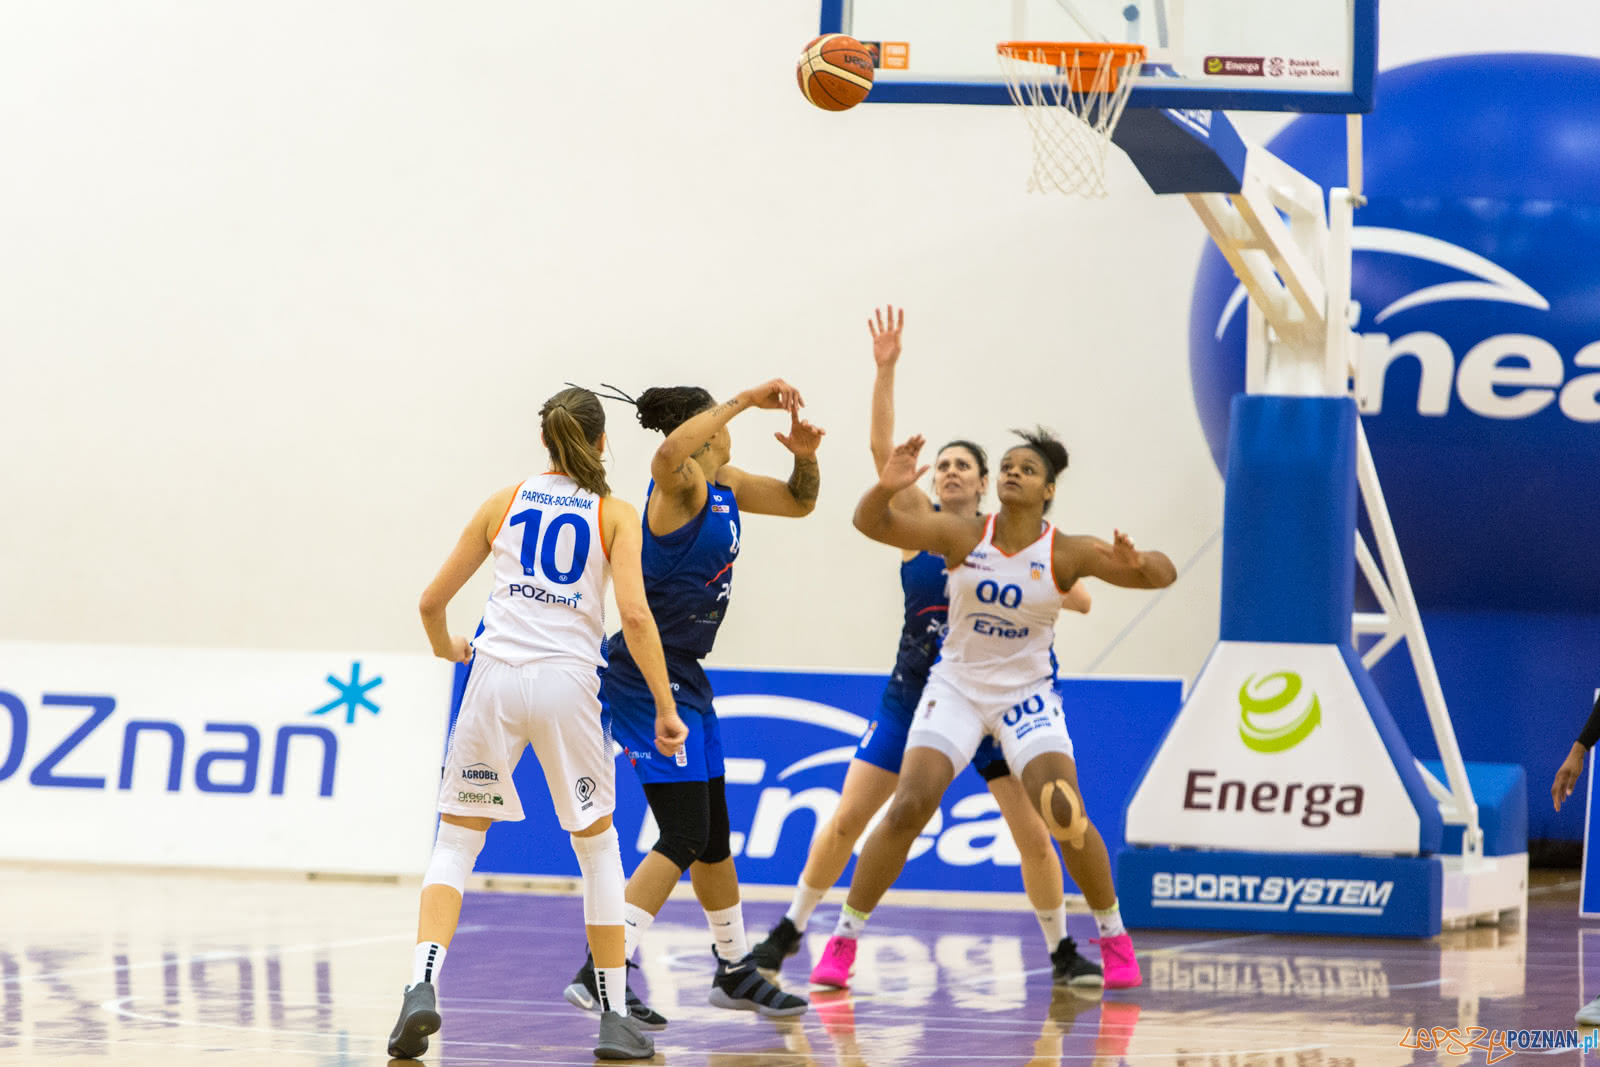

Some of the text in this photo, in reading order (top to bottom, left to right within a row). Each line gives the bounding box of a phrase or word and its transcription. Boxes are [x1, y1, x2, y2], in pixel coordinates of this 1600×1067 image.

[1348, 331, 1600, 423] ne
[521, 490, 594, 510] PARYSEK-BOCHNIAK
[509, 508, 591, 585] 10
[976, 580, 1023, 608] 00
[973, 619, 1029, 638] Enea
[1002, 694, 1045, 727] 00
[462, 769, 499, 781] AGROBEX
[458, 791, 491, 803] green
[1183, 768, 1365, 829] Energa
[1151, 872, 1394, 911] SPORTSYSTEM
